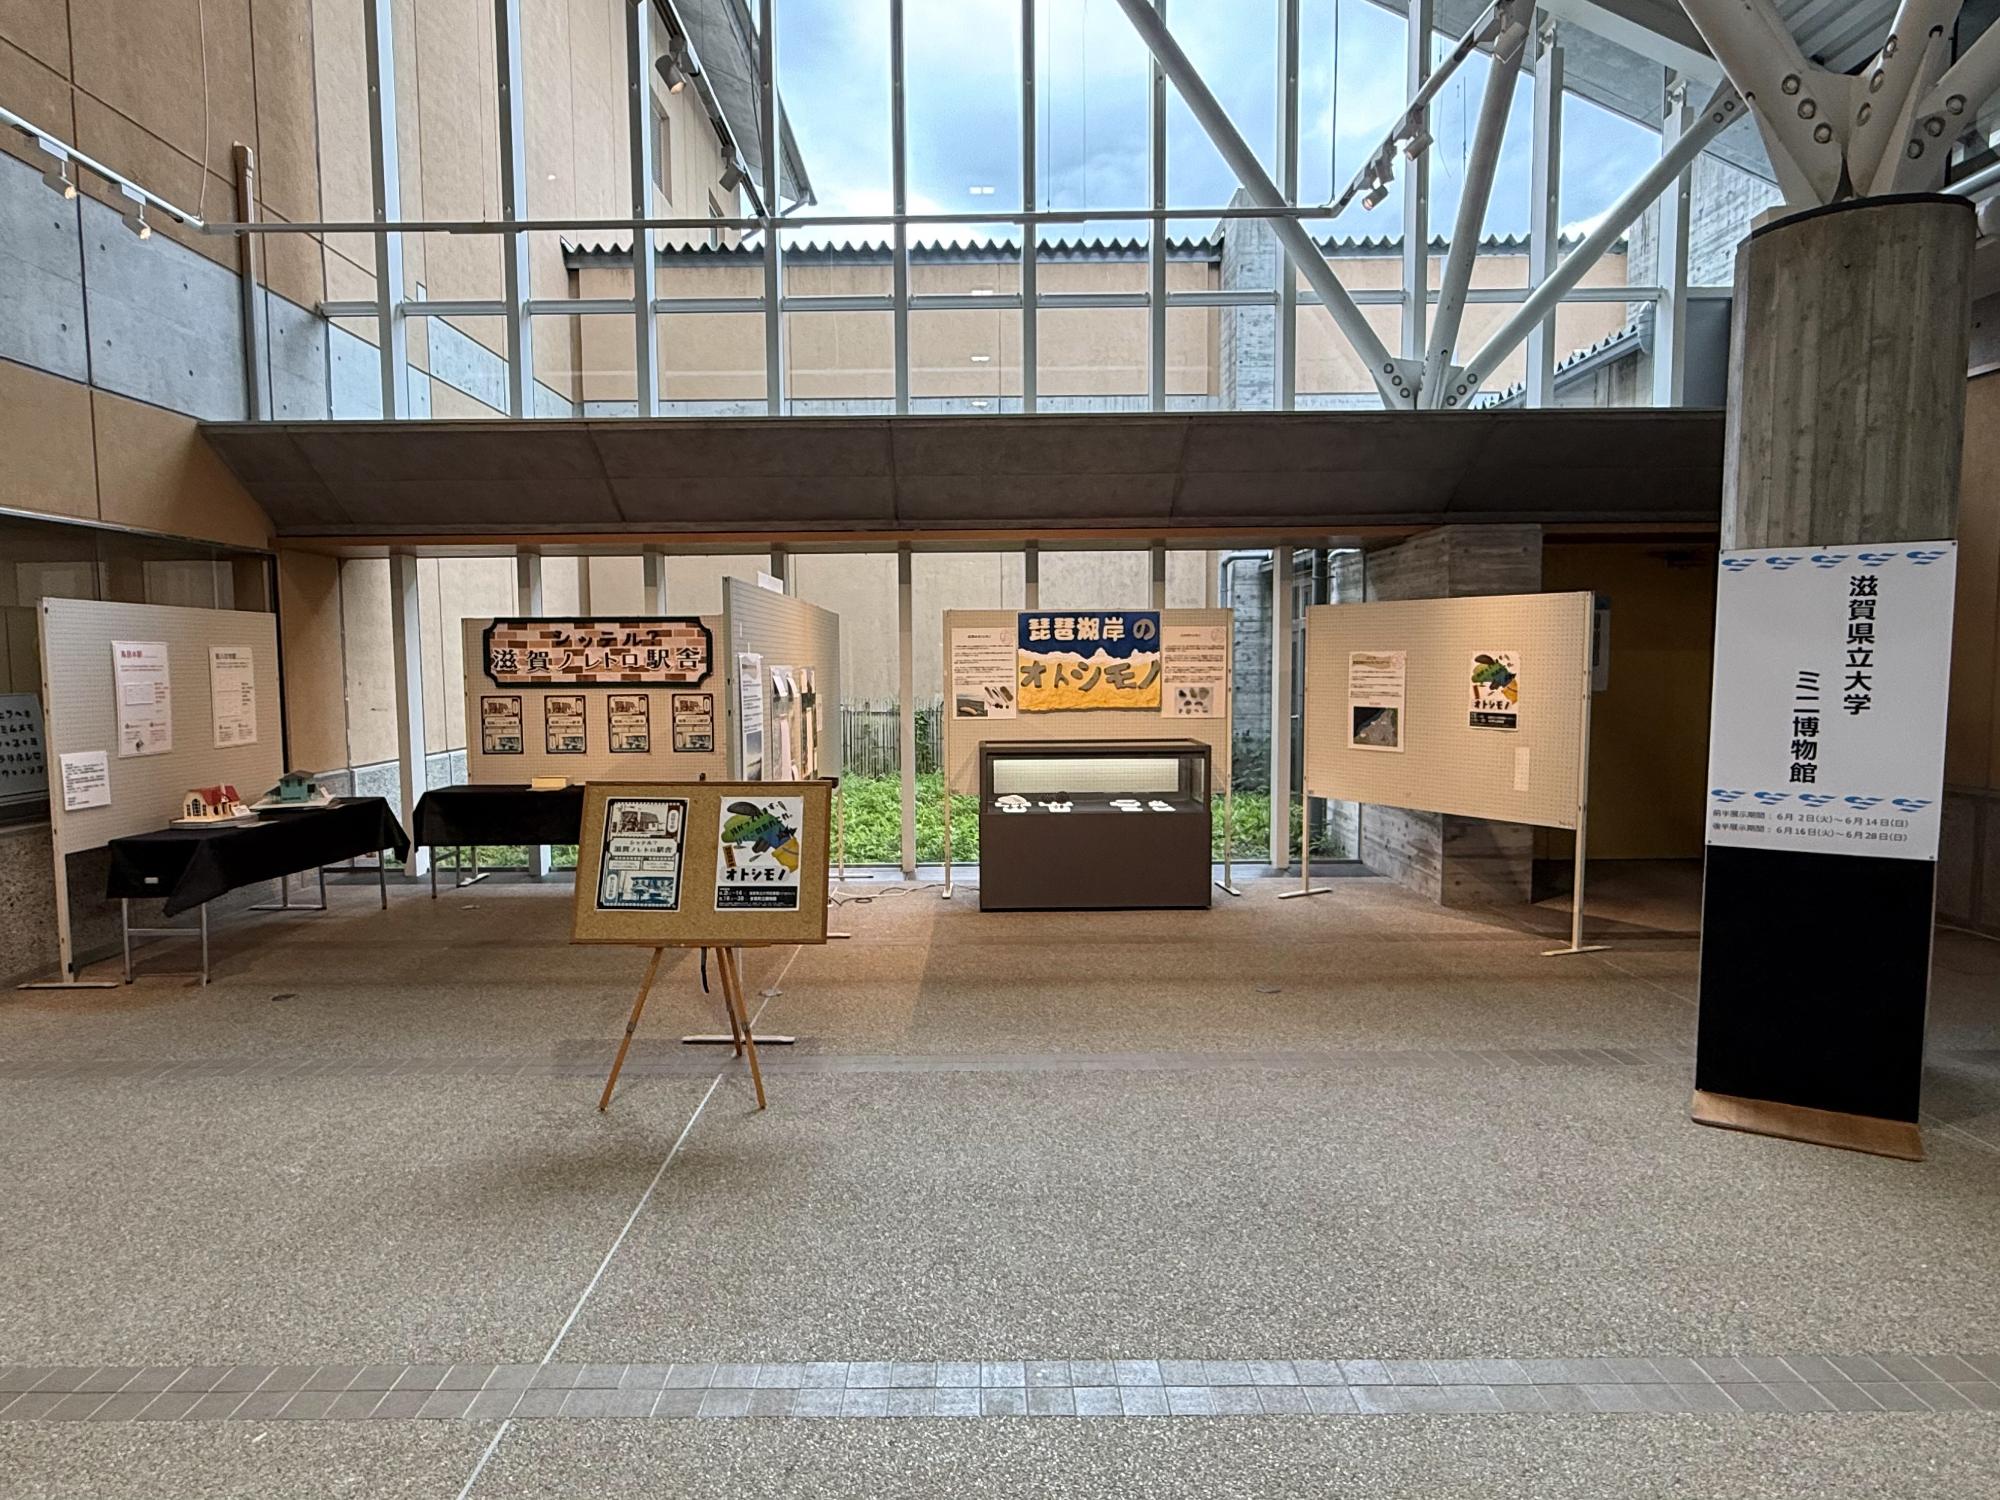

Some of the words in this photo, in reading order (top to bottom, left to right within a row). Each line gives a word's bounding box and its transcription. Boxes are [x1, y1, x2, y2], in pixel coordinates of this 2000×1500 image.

[552, 630, 660, 648] シッテル？
[1027, 617, 1156, 642] 琵琶湖岸の
[1843, 575, 1878, 716] 滋賀県立大学
[493, 647, 702, 672] 滋賀ノレトロ駅舎
[1020, 660, 1161, 692] オトシモノ
[1473, 700, 1510, 710] オトシモノ
[1789, 670, 1820, 784] ミニ博物館
[726, 868, 786, 881] オトシモノ
